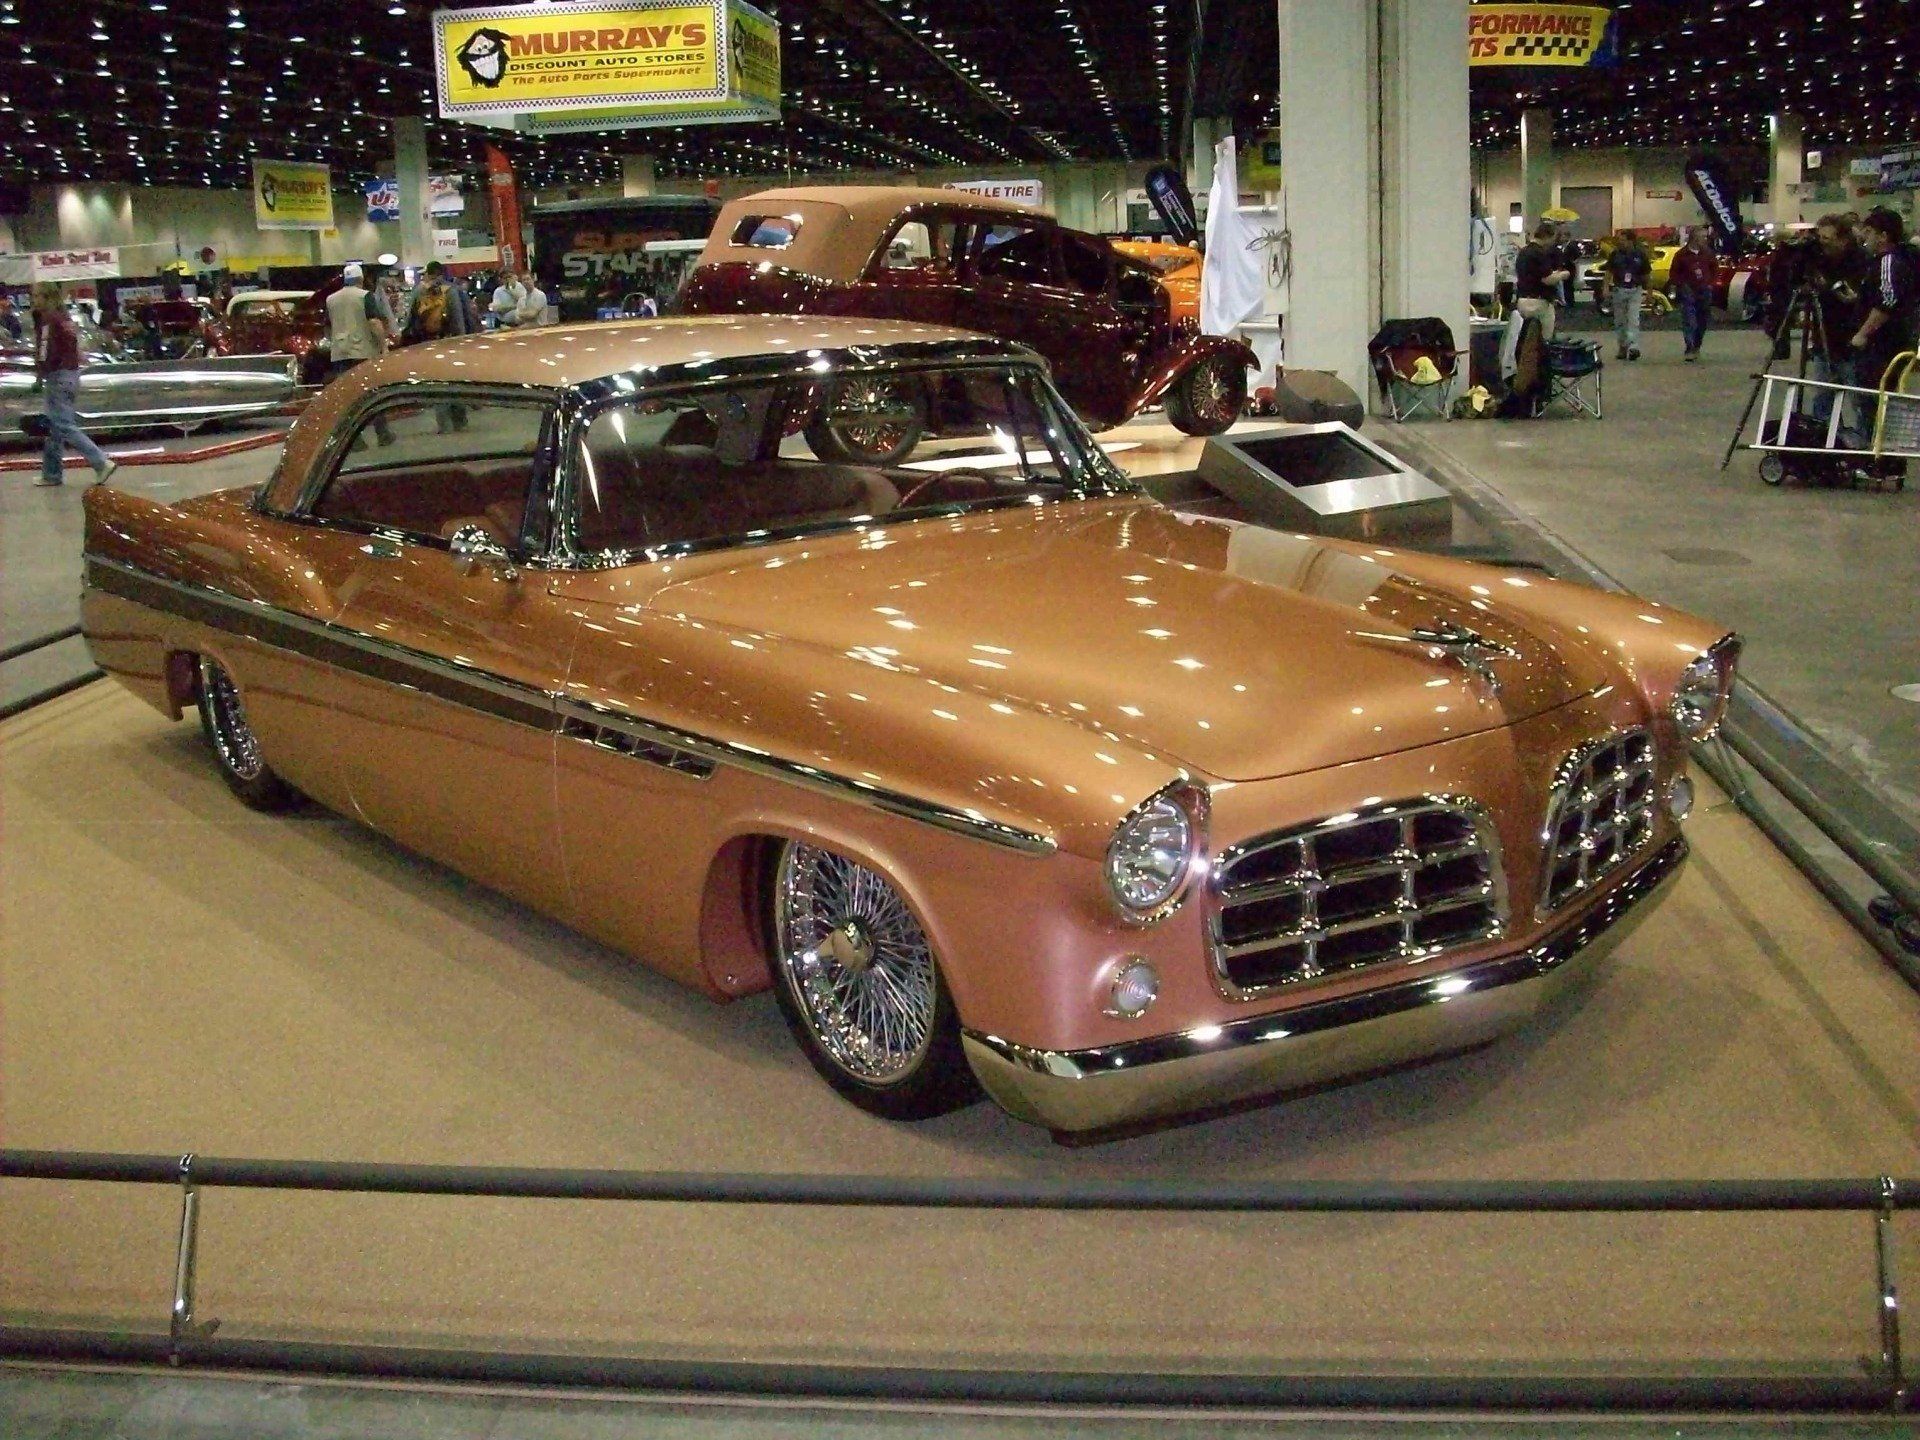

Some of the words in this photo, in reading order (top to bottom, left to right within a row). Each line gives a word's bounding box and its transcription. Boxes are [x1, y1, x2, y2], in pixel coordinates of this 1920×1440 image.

[1468, 13, 1592, 36] FORMANCE
[510, 23, 706, 57] MURRAY'S
[510, 59, 586, 72] DISCOUNT
[595, 56, 637, 67] AUTO
[645, 52, 705, 63] STORES
[512, 76, 535, 85] The
[538, 73, 569, 84] Auto
[573, 71, 610, 82] Parts
[614, 66, 701, 80] Supermarket
[1003, 185, 1034, 197] TIRE
[1694, 169, 1736, 232] ACDelco
[438, 238, 457, 247] TIRE
